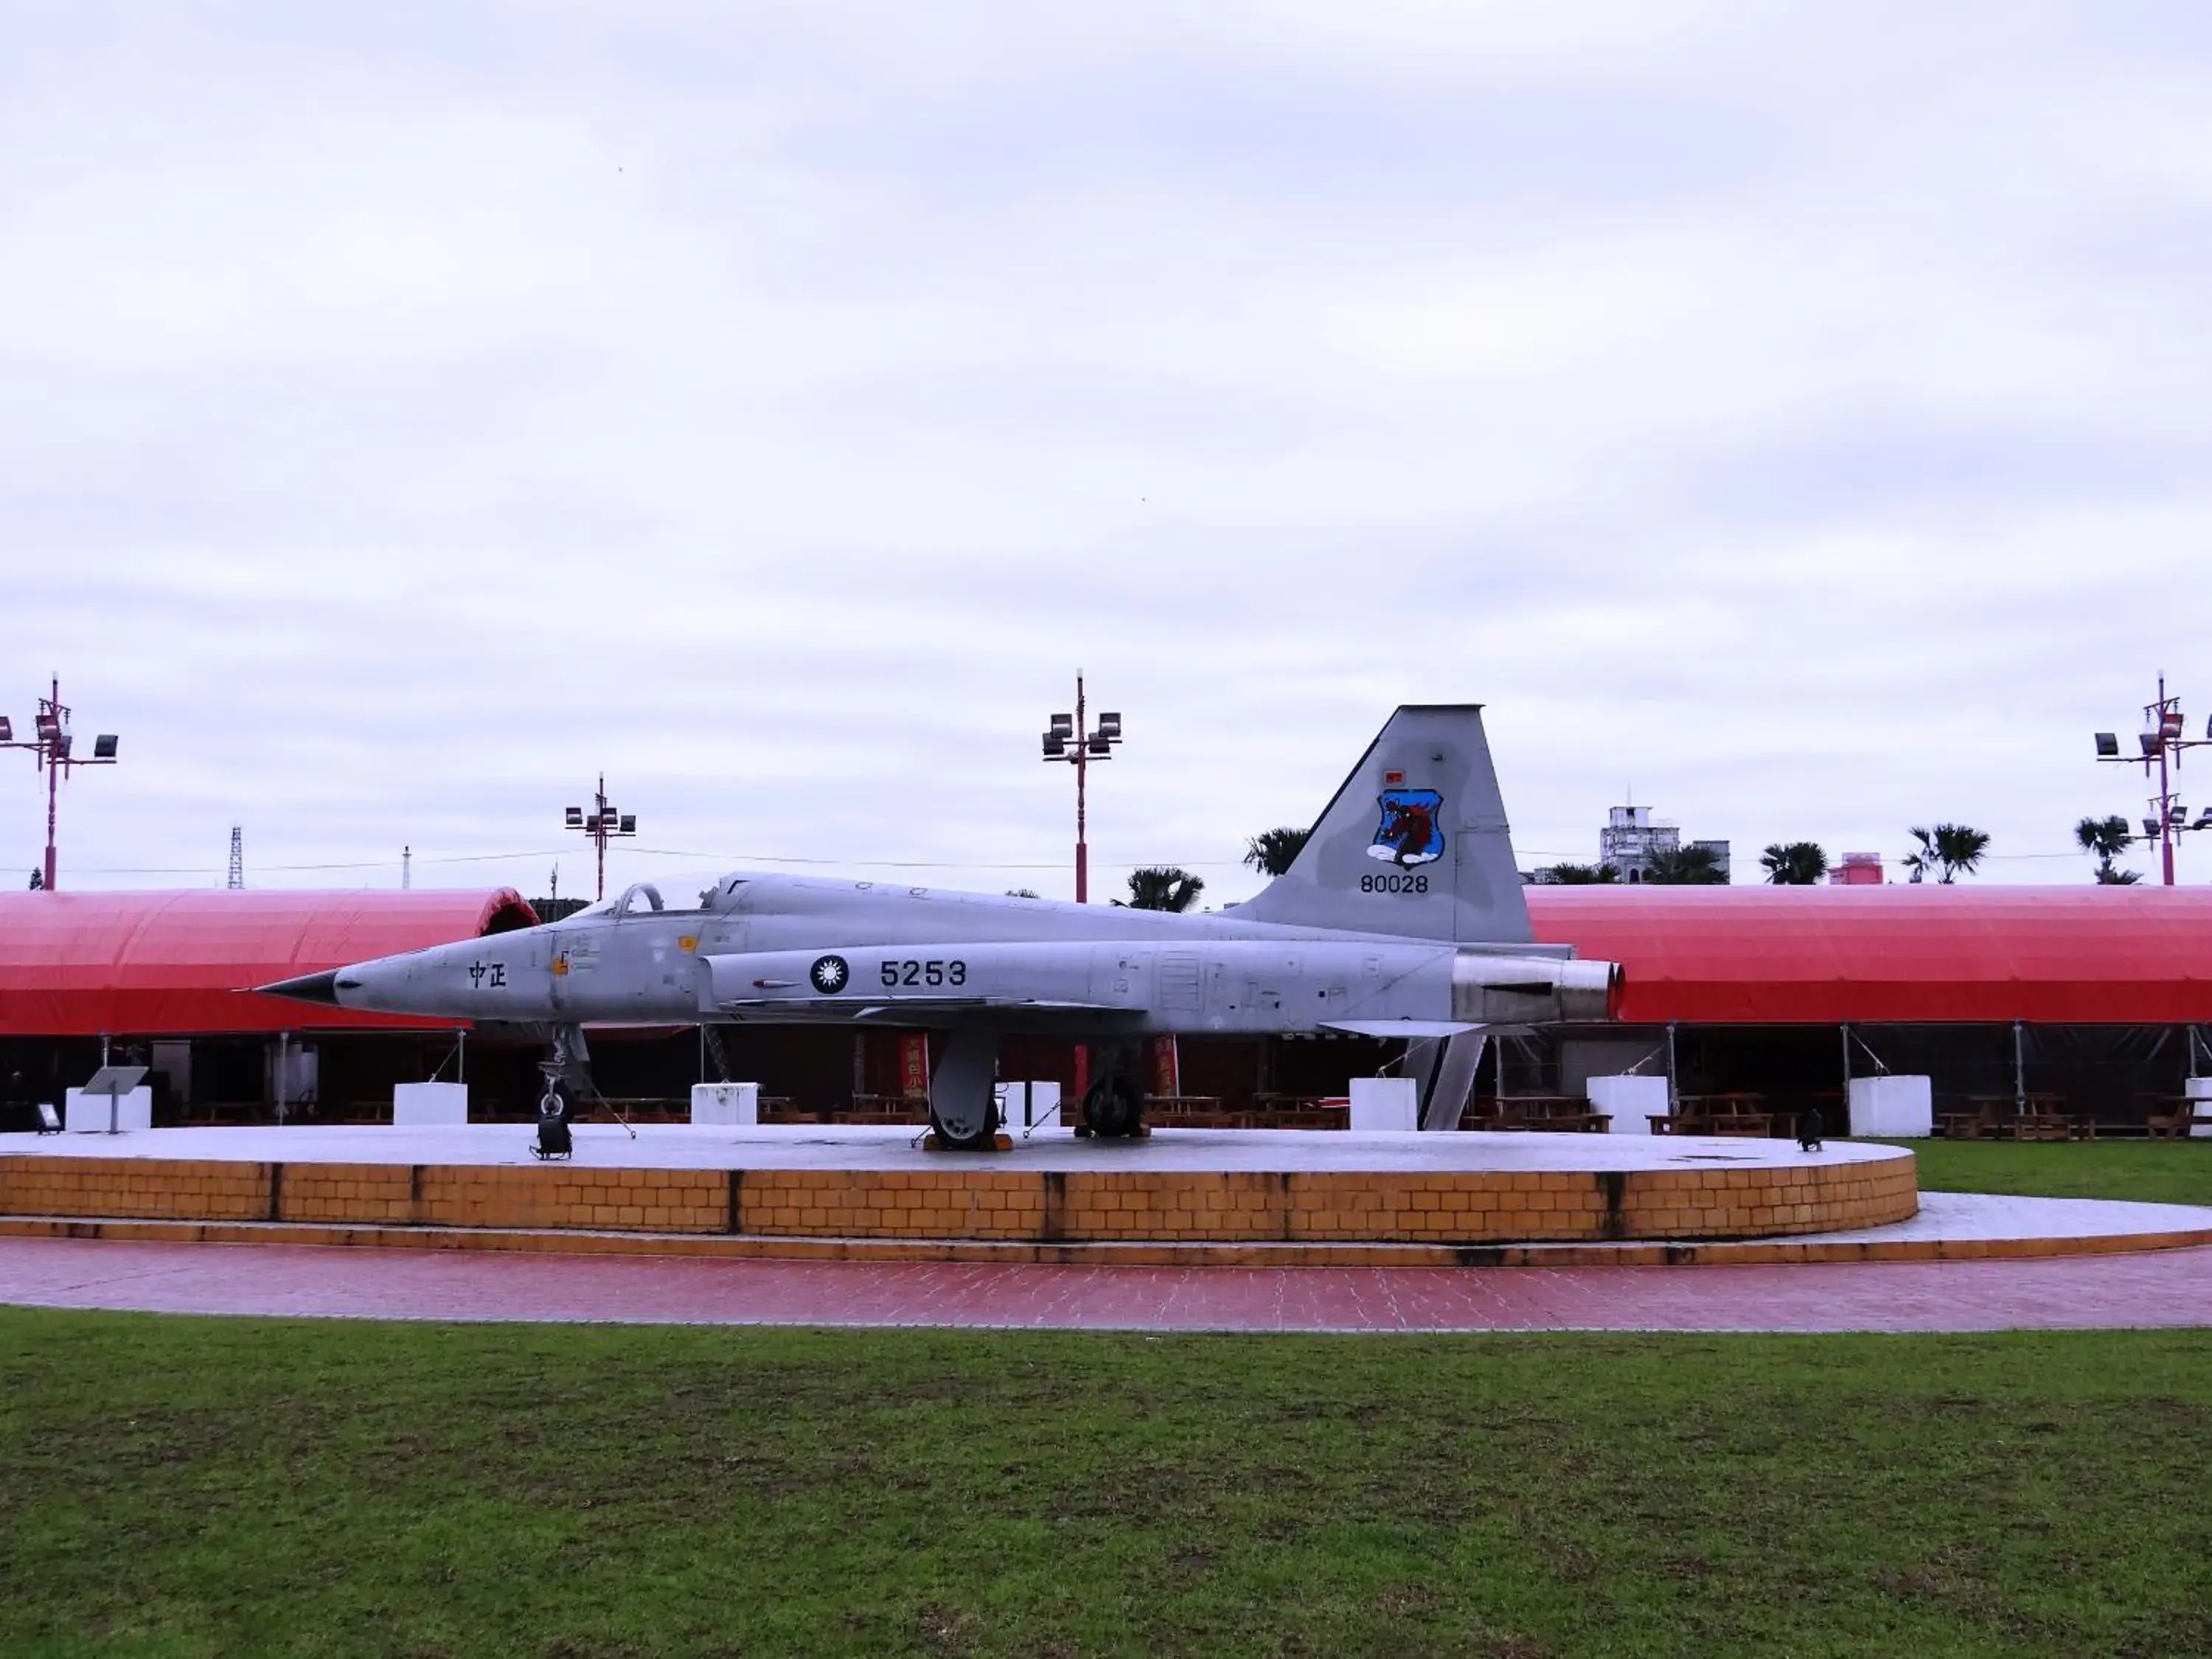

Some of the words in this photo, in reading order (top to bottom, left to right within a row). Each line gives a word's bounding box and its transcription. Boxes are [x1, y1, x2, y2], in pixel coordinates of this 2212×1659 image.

[1360, 874, 1428, 893] 80028
[468, 961, 506, 988] 中正
[881, 960, 966, 986] 5253
